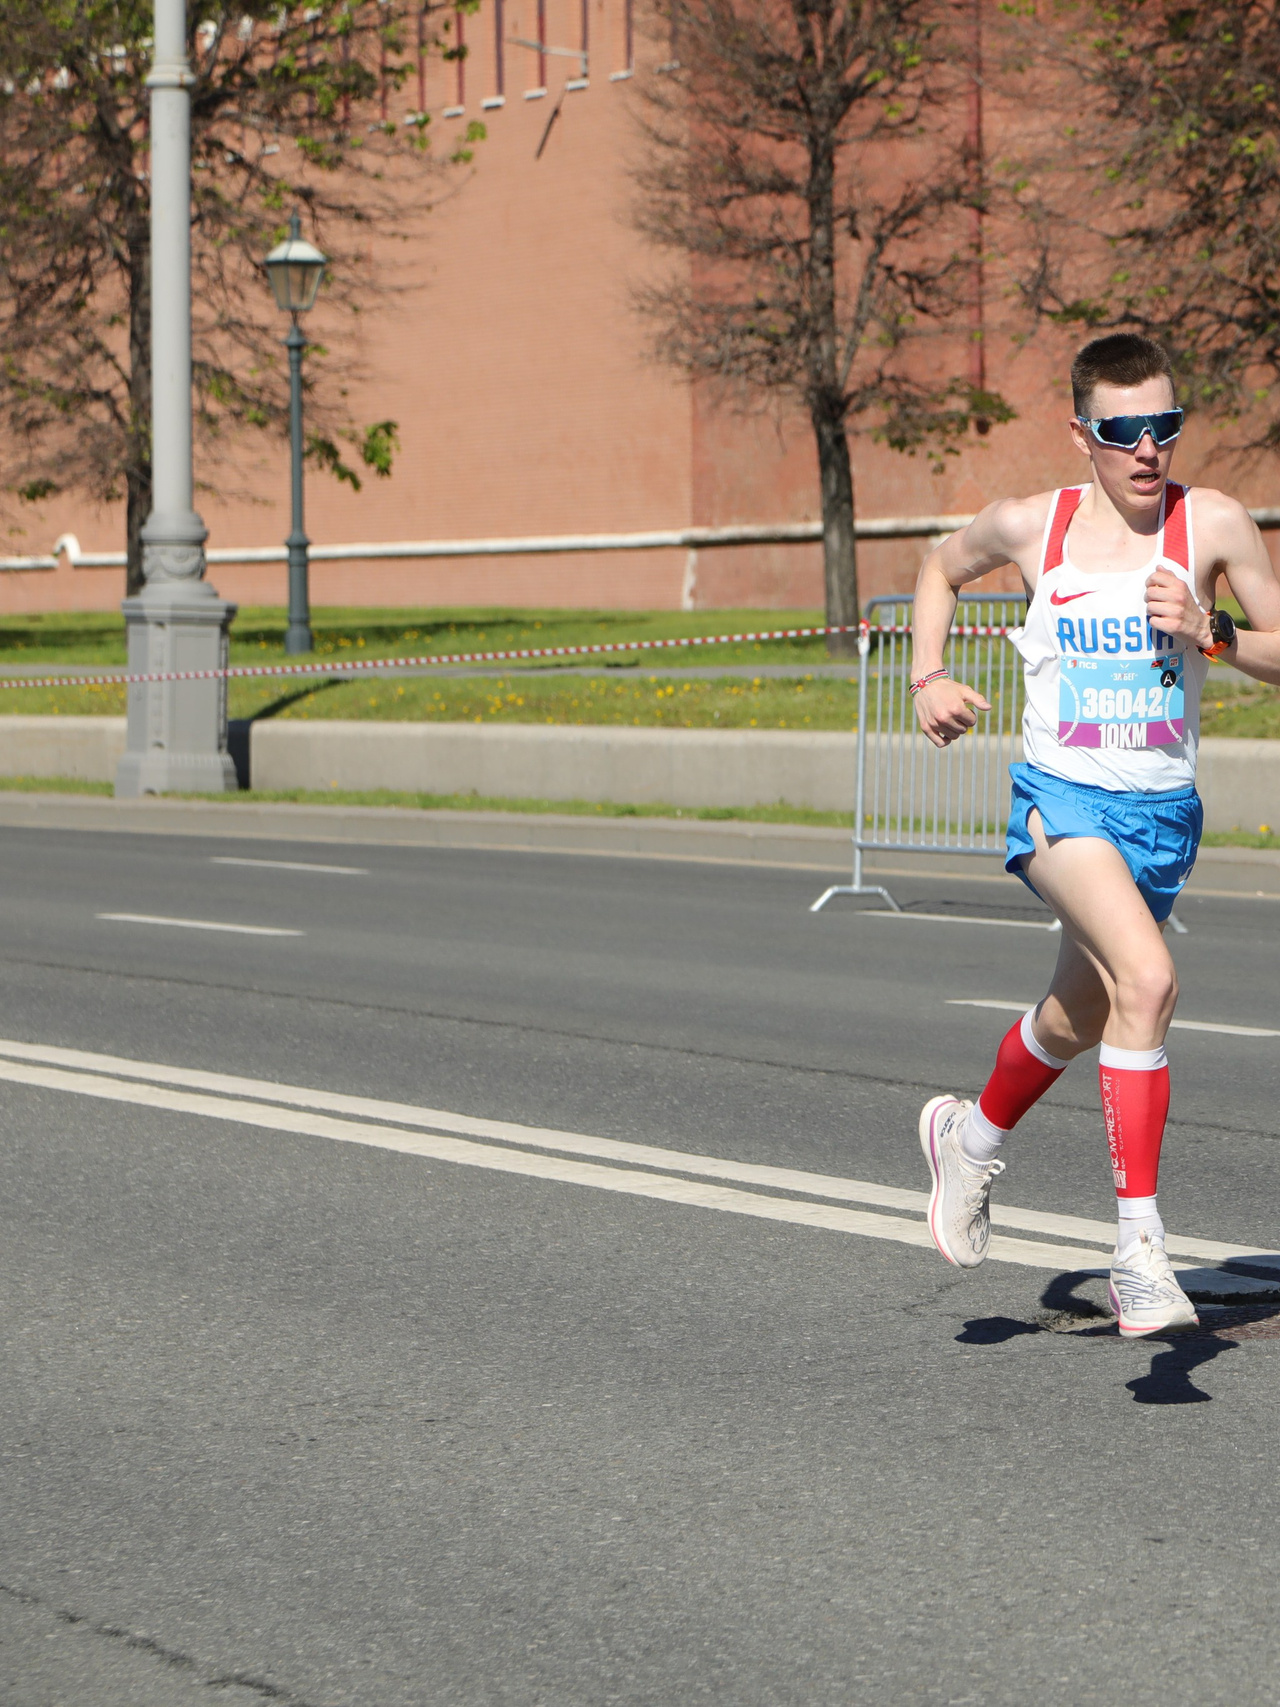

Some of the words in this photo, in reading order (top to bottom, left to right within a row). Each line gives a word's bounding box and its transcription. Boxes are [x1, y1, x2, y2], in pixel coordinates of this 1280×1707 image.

[1163, 674, 1173, 686] A
[1082, 687, 1163, 719] 36042
[1098, 723, 1147, 748] 10KM
